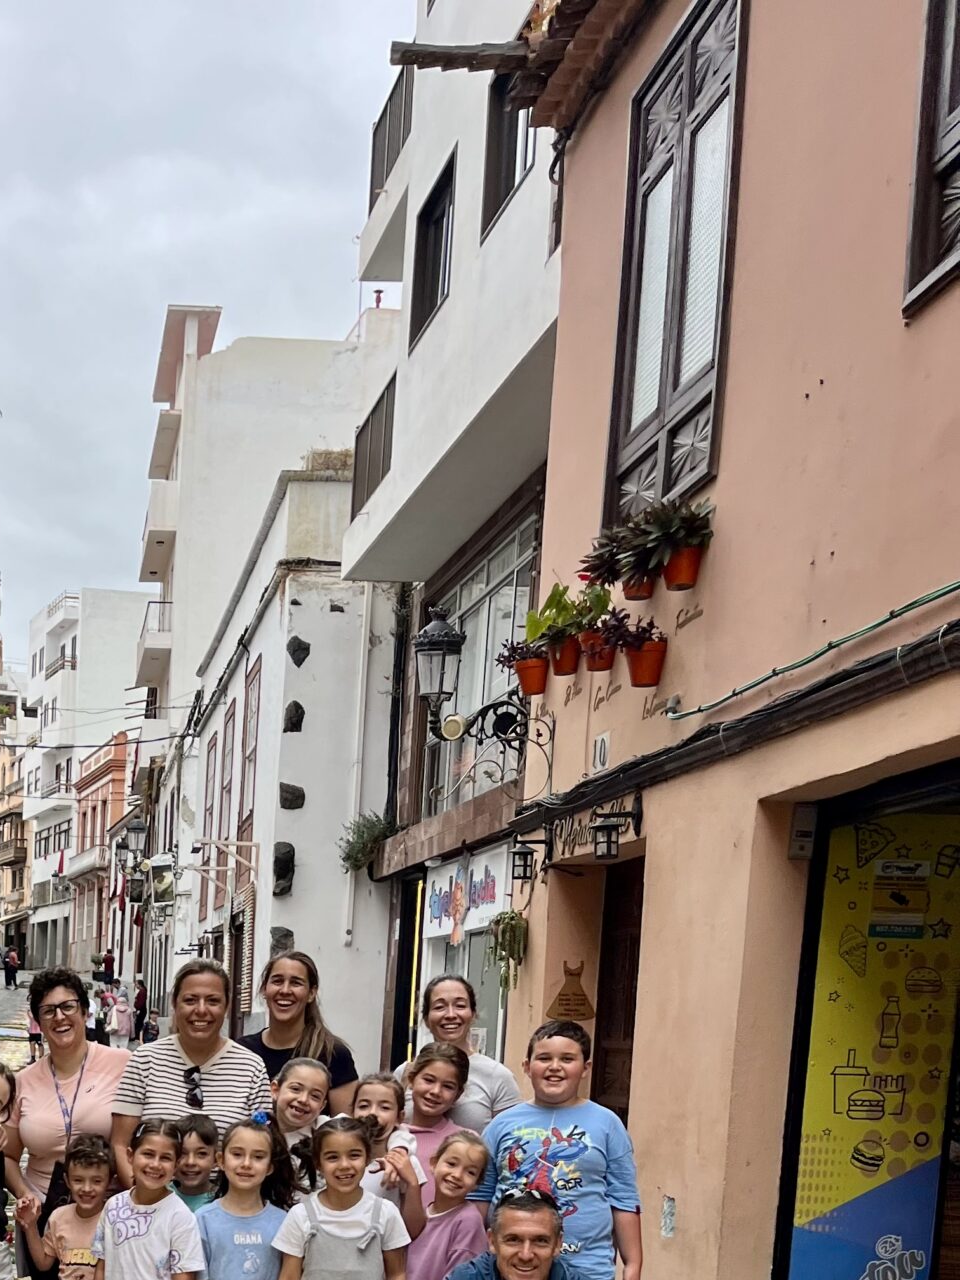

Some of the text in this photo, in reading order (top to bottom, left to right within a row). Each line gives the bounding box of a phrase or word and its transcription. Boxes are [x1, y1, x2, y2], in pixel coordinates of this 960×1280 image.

[592, 737, 608, 770] 10
[112, 1214, 153, 1247] DAY
[233, 1233, 263, 1245] OHANA
